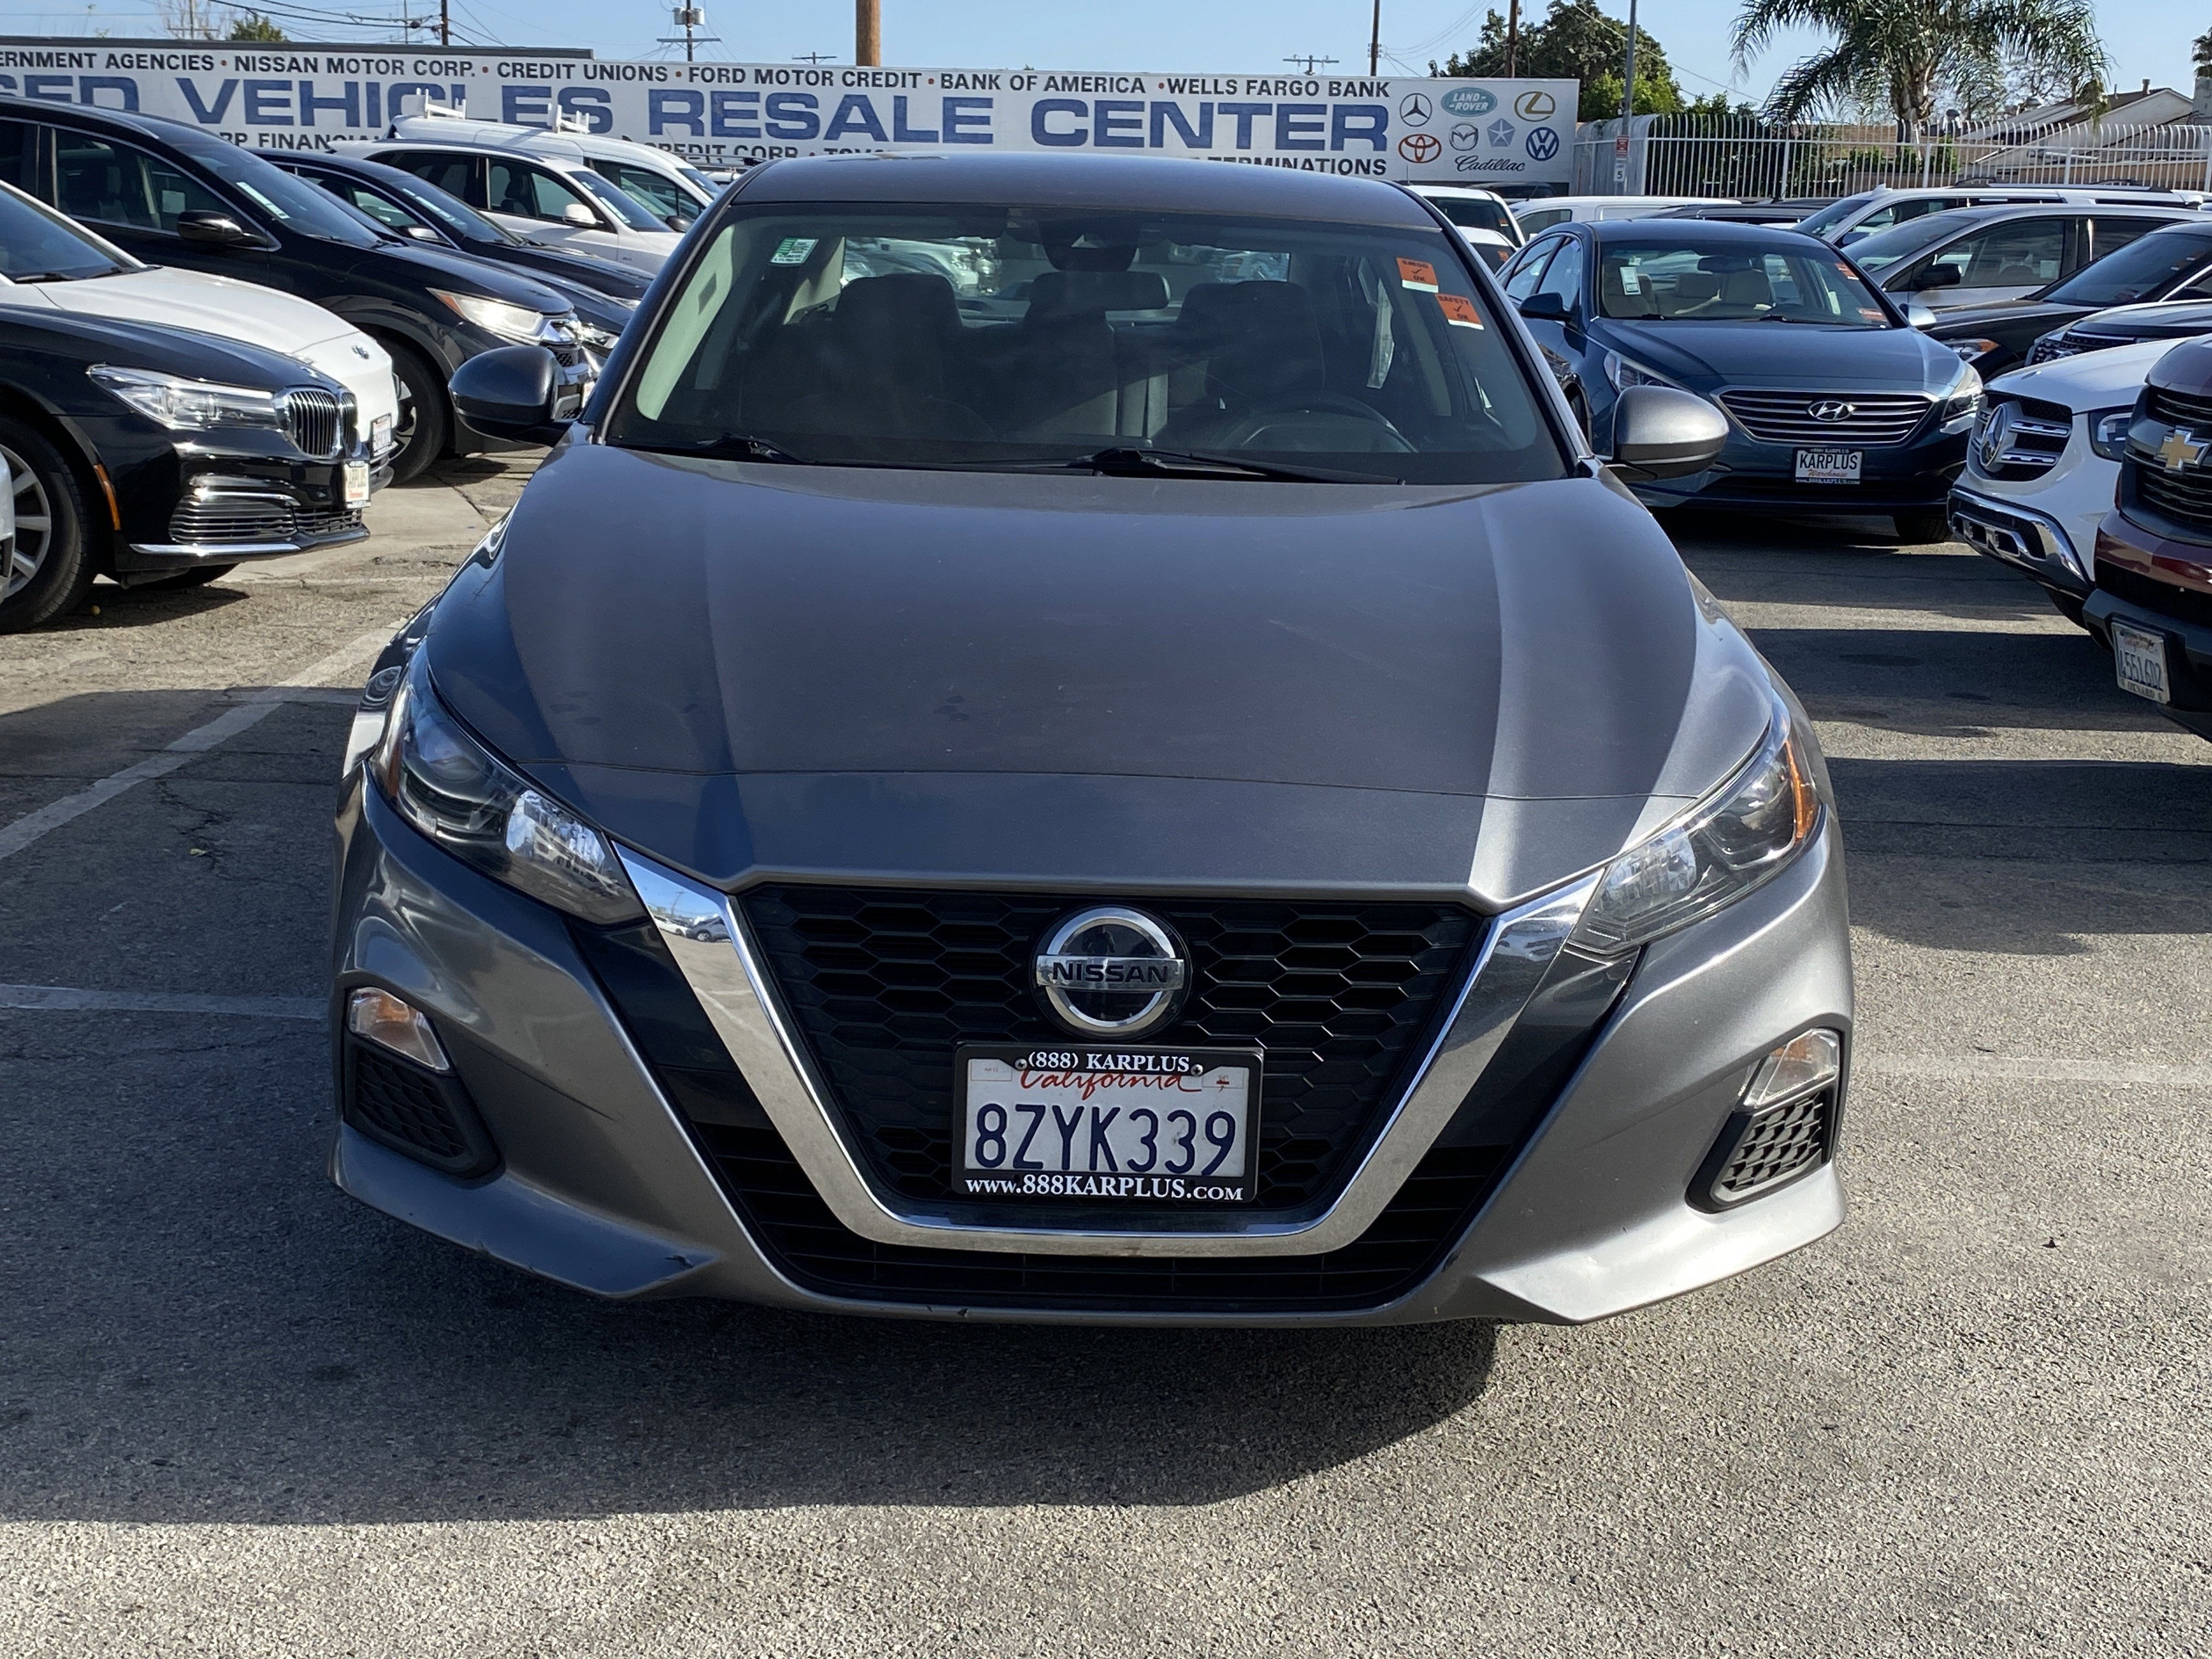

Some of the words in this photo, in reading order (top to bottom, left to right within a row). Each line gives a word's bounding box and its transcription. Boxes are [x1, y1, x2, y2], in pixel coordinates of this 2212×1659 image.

[105, 53, 215, 71] AGENCIES
[234, 55, 318, 72] NISSAN
[326, 58, 405, 75] MOTOR
[414, 59, 476, 77] CORP.
[496, 61, 575, 80] CREDIT
[583, 64, 668, 82] UNIONS
[688, 66, 746, 84] FORD
[754, 67, 833, 86] MOTOR
[842, 70, 922, 89] CREDIT
[940, 73, 1001, 91] BANK
[1009, 75, 1038, 92] OF
[1043, 75, 1146, 94] AMERICA
[1167, 78, 1238, 95] WELLS
[1246, 80, 1320, 97] FARGO
[1328, 81, 1390, 98] BANK
[648, 88, 994, 144] RESALE
[1031, 98, 1389, 152] CENTER
[258, 132, 379, 150] FINAN
[1454, 155, 1526, 172] Cadillac
[1617, 171, 1623, 179] 5
[1437, 295, 1469, 306] SAFETY
[1799, 453, 1858, 470] KARPLUS
[1052, 962, 1168, 983] NISSAN
[1028, 1051, 1079, 1069] (888)
[1086, 1053, 1190, 1073] KARPLUS
[1020, 1069, 1203, 1101] California
[974, 1103, 1237, 1176] 8ZYK339
